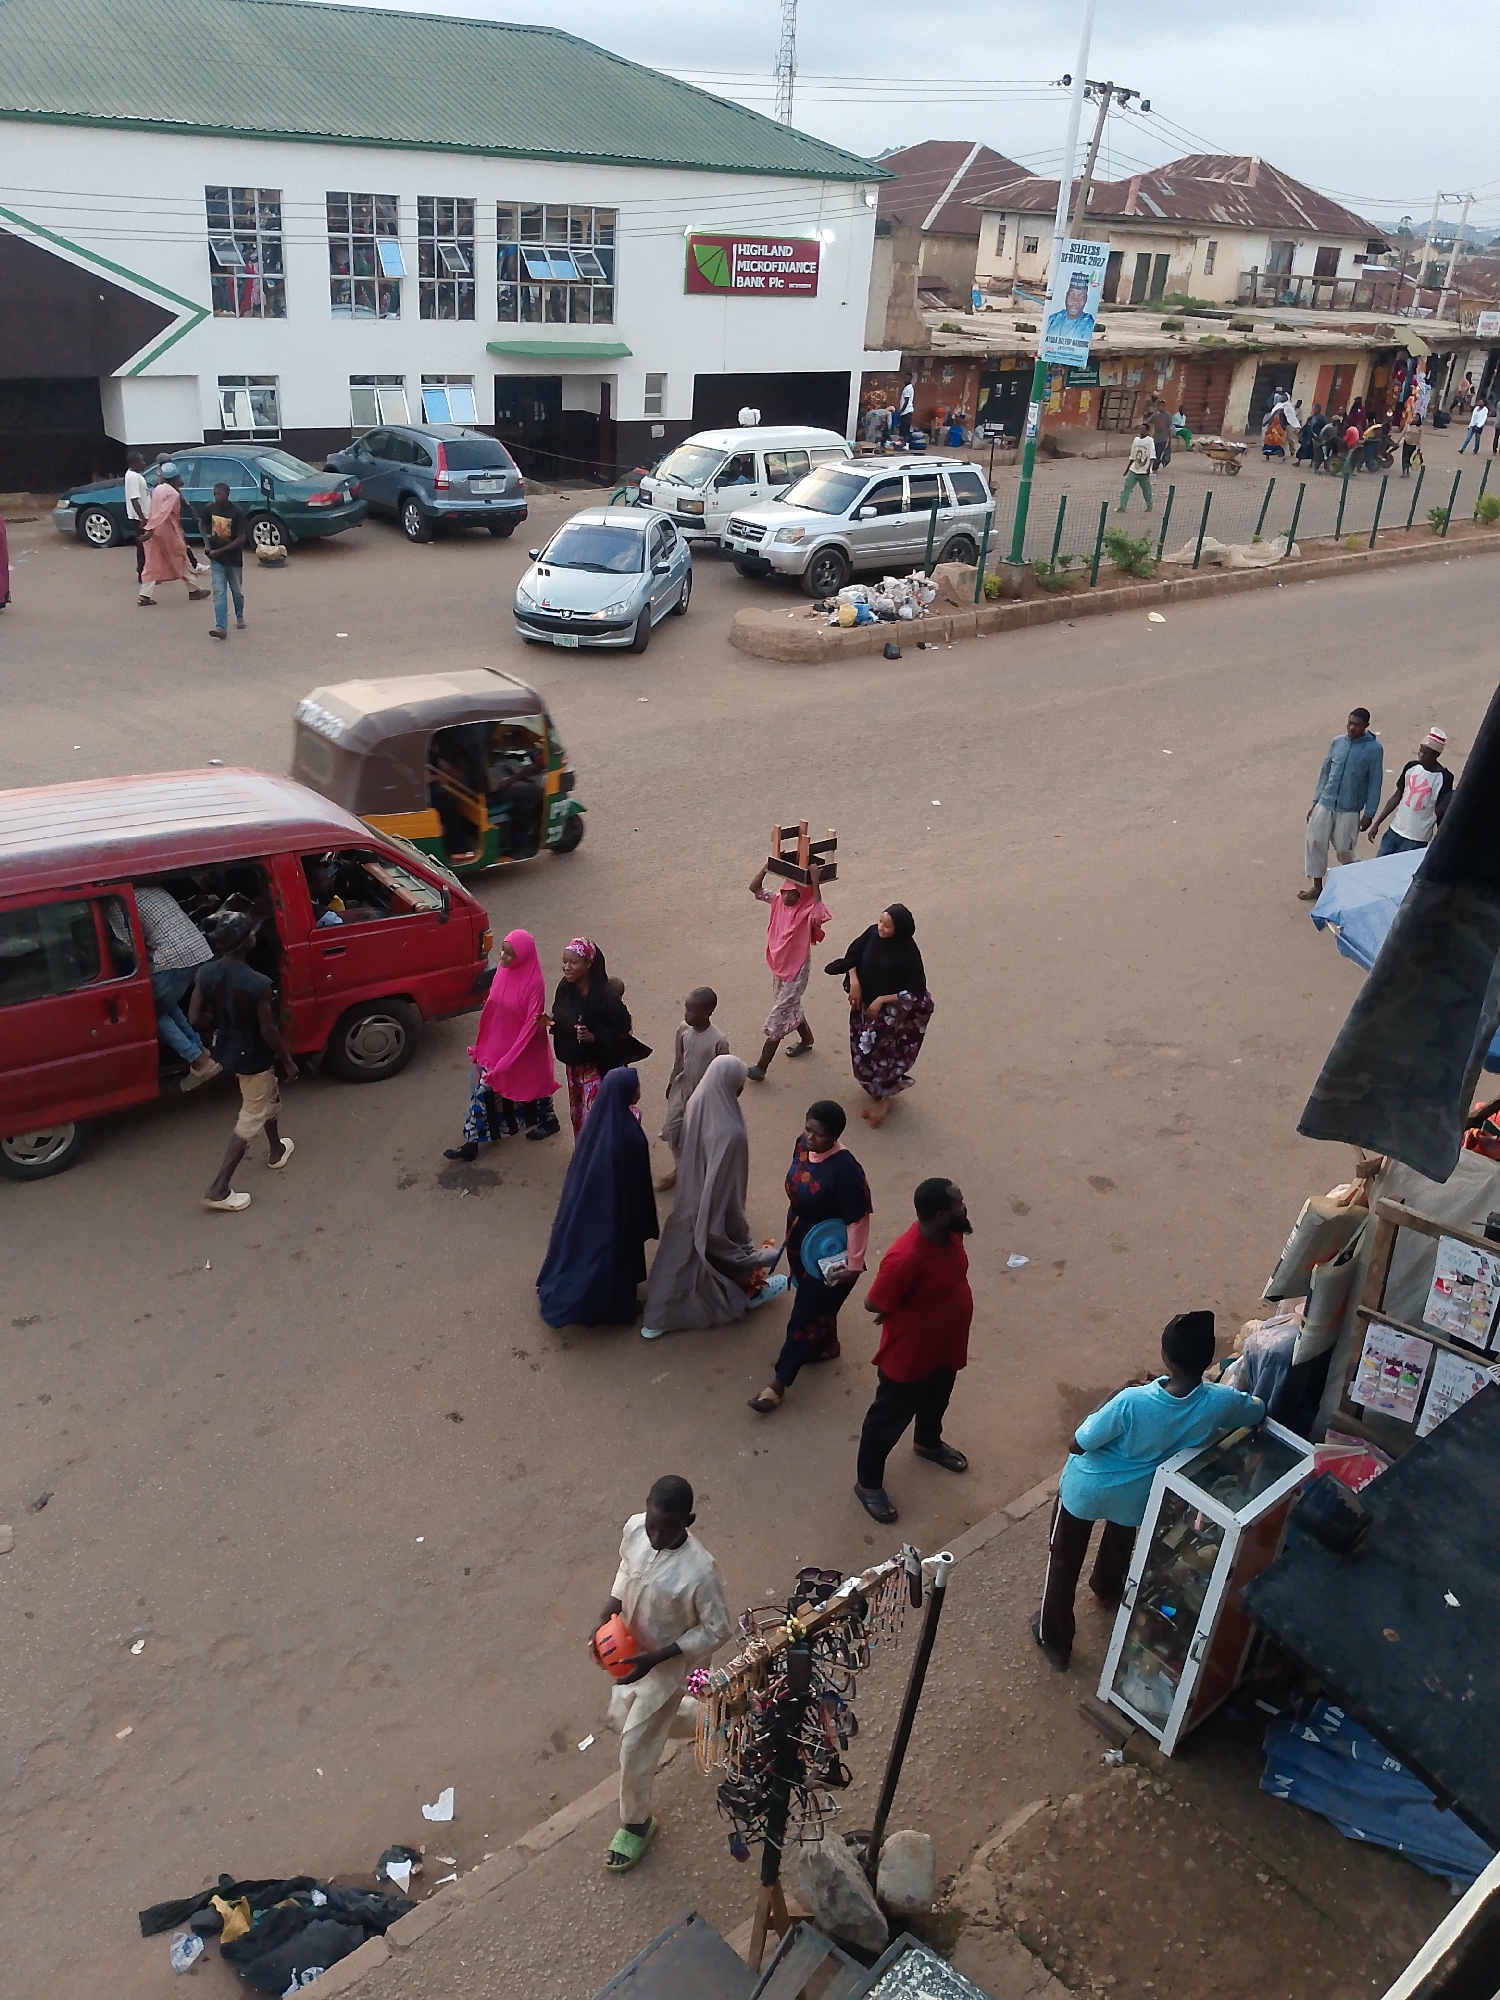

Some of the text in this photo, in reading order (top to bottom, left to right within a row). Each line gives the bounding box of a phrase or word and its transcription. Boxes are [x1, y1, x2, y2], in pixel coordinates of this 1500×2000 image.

[738, 243, 794, 257] HIGHLAND
[1070, 243, 1100, 256] SELFLESS
[736, 260, 817, 274] MICROFINANCE
[1060, 252, 1106, 268] SERVICE 2027
[736, 275, 766, 288] BANK
[768, 276, 785, 288] Plc
